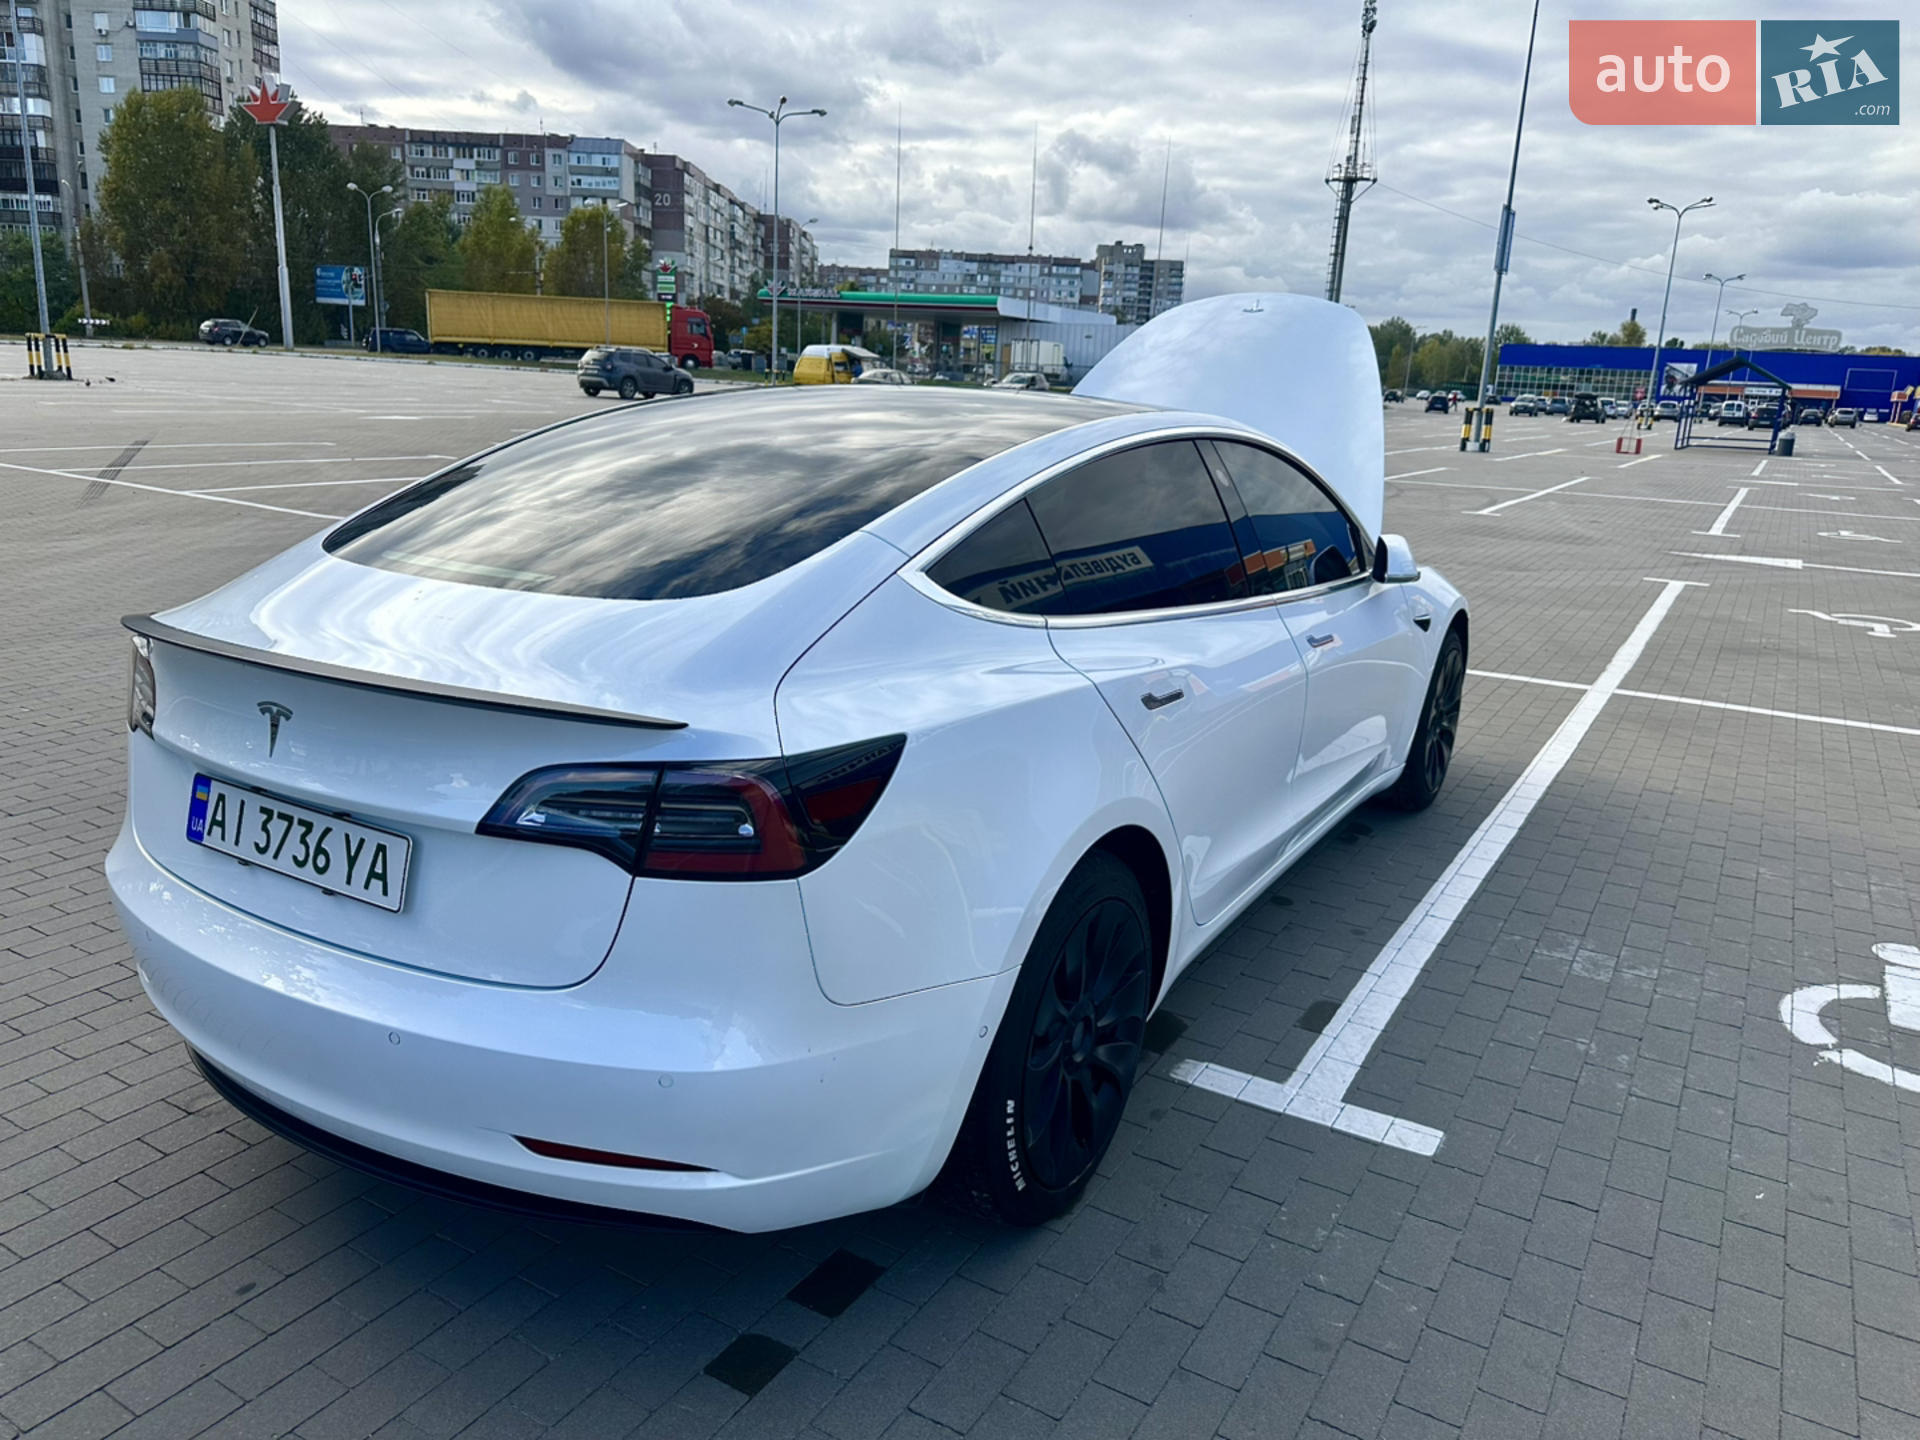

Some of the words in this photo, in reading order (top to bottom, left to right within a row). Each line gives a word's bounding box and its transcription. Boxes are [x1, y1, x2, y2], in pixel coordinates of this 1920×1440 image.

[654, 193, 671, 206] 20
[1733, 328, 1788, 348] Садовий
[1793, 330, 1839, 349] Центр
[191, 817, 204, 832] UA
[253, 806, 333, 876] 3736
[344, 832, 389, 896] YA
[1005, 1099, 1027, 1192] MICHELIN
